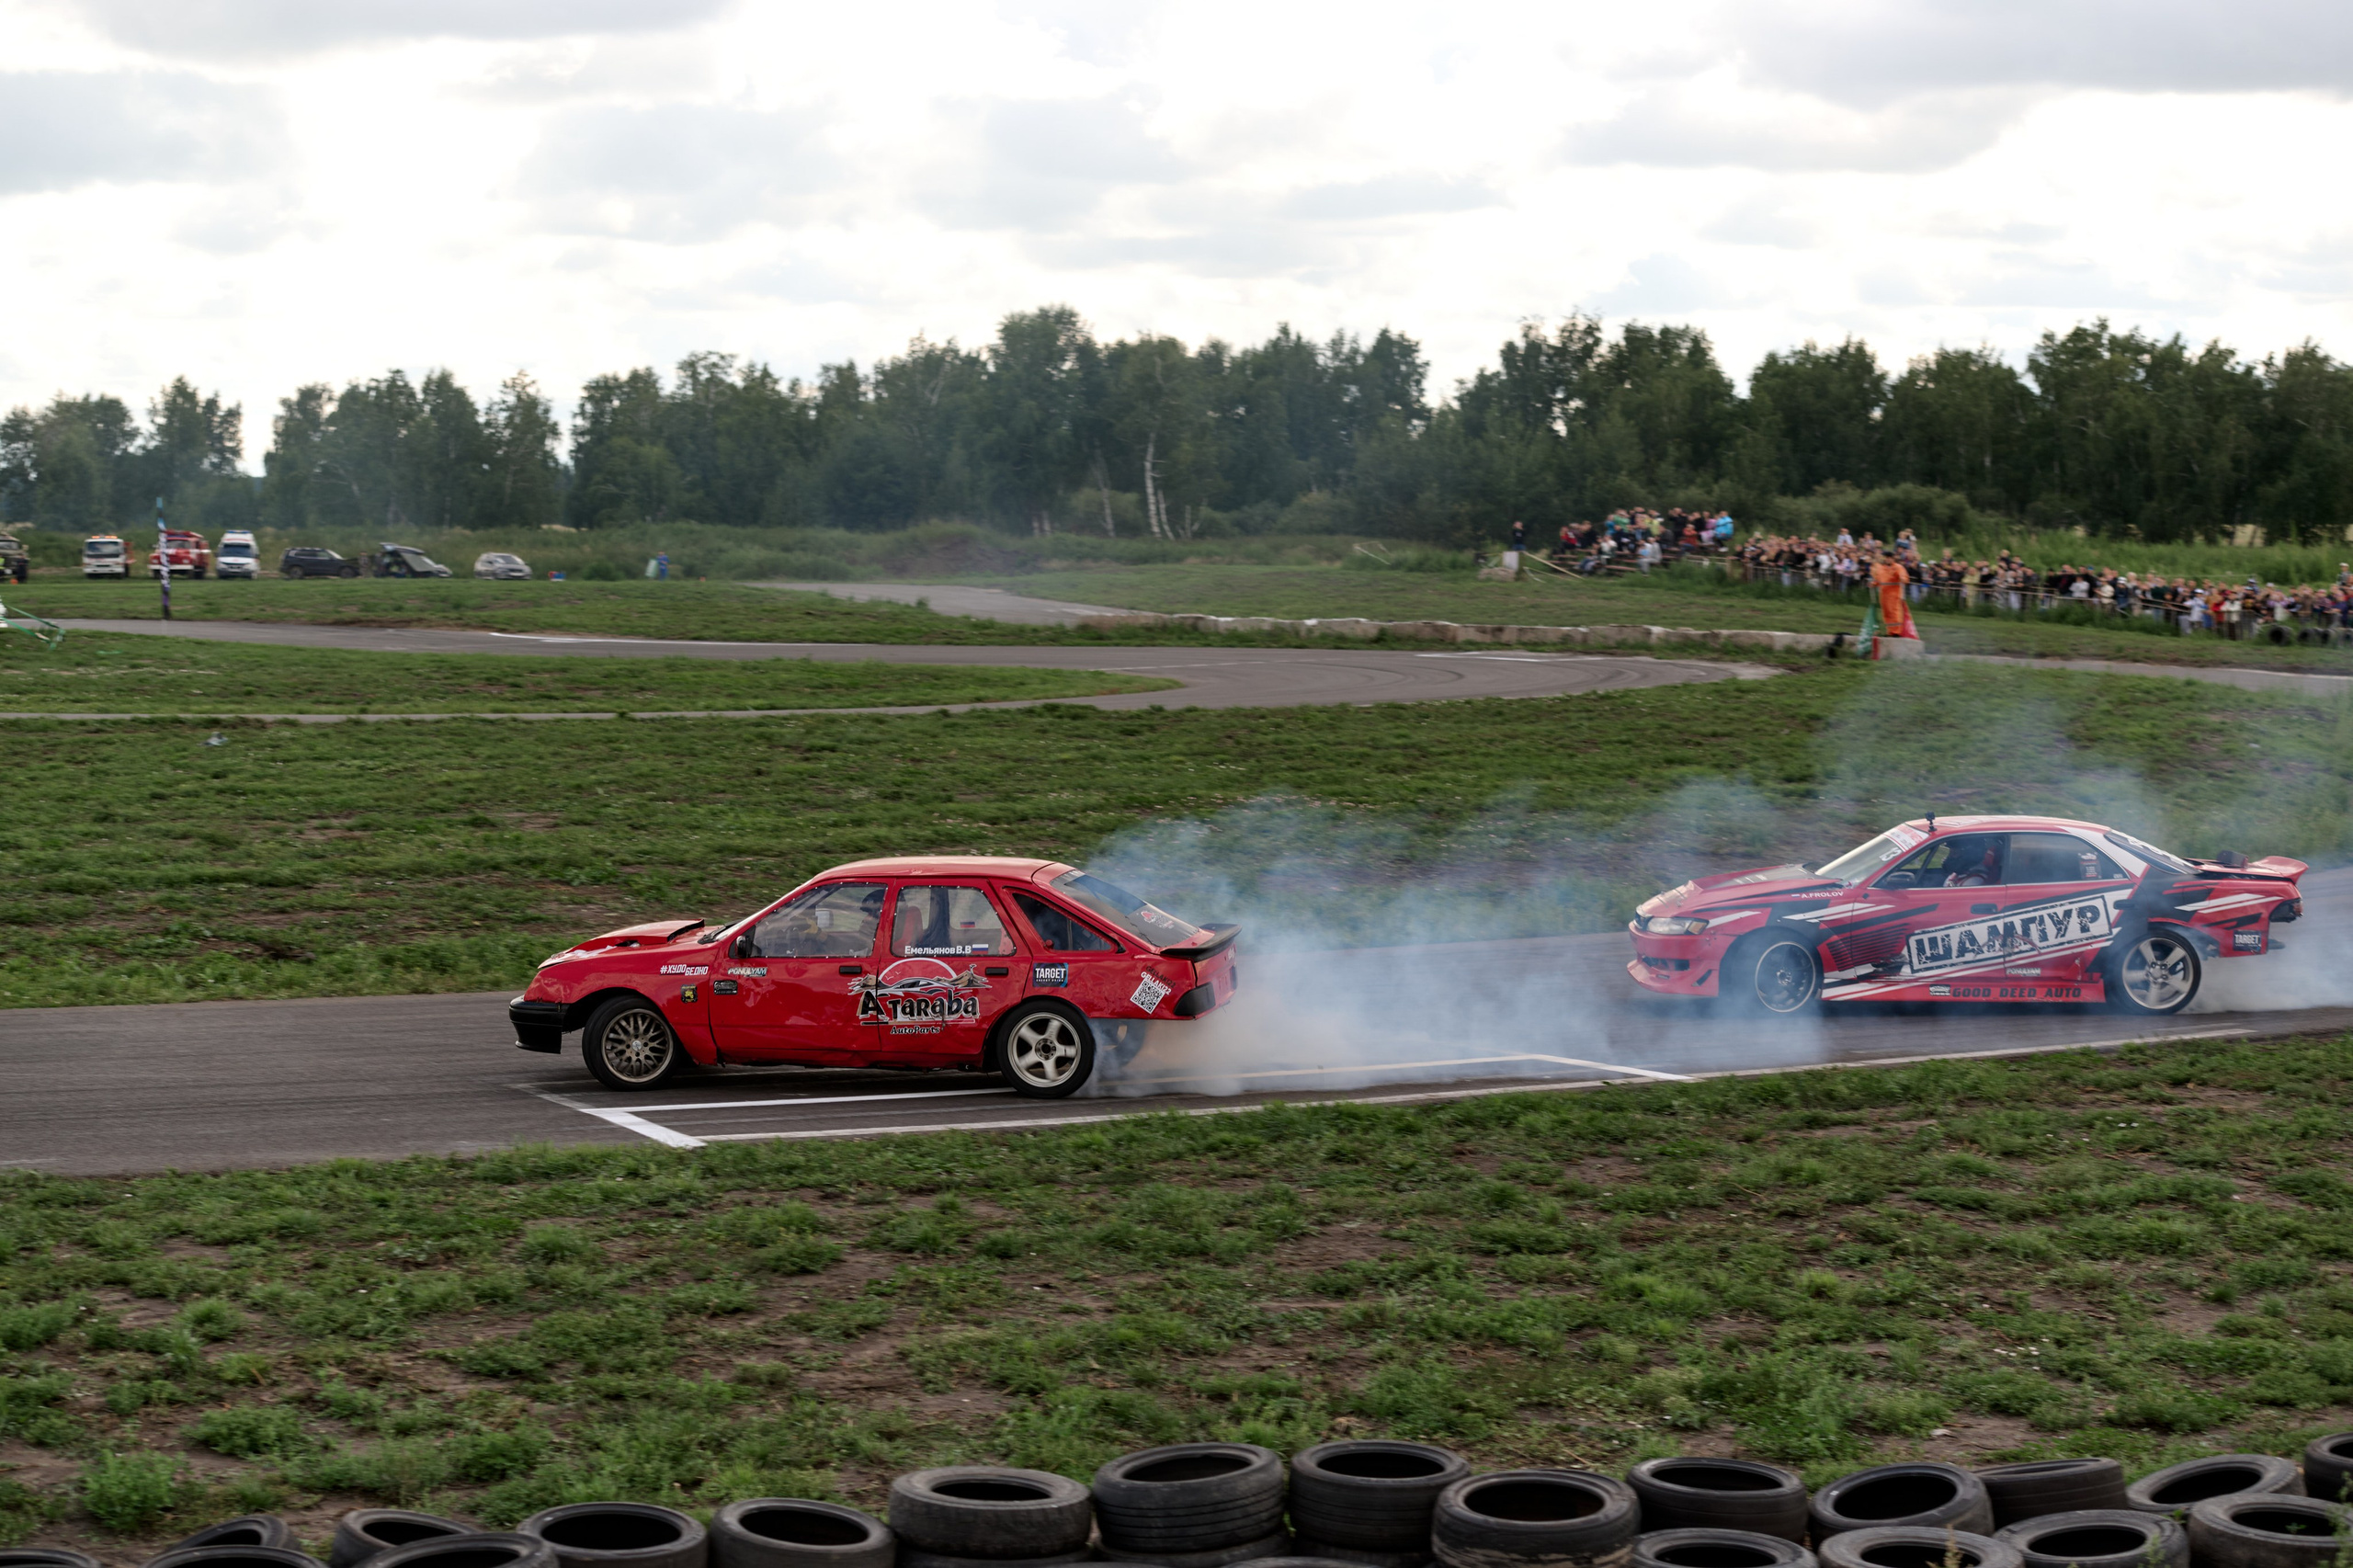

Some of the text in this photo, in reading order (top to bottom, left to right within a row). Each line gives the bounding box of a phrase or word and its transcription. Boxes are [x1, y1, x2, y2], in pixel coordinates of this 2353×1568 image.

[1915, 904, 2101, 965] ШАМПУР
[904, 945, 955, 954] Емельянов
[1035, 968, 1066, 979] TARGET
[1141, 971, 1172, 995] GELLAKI22
[1952, 987, 2082, 998] GOOD DEED AUTO
[890, 1026, 941, 1035] AutoParts
